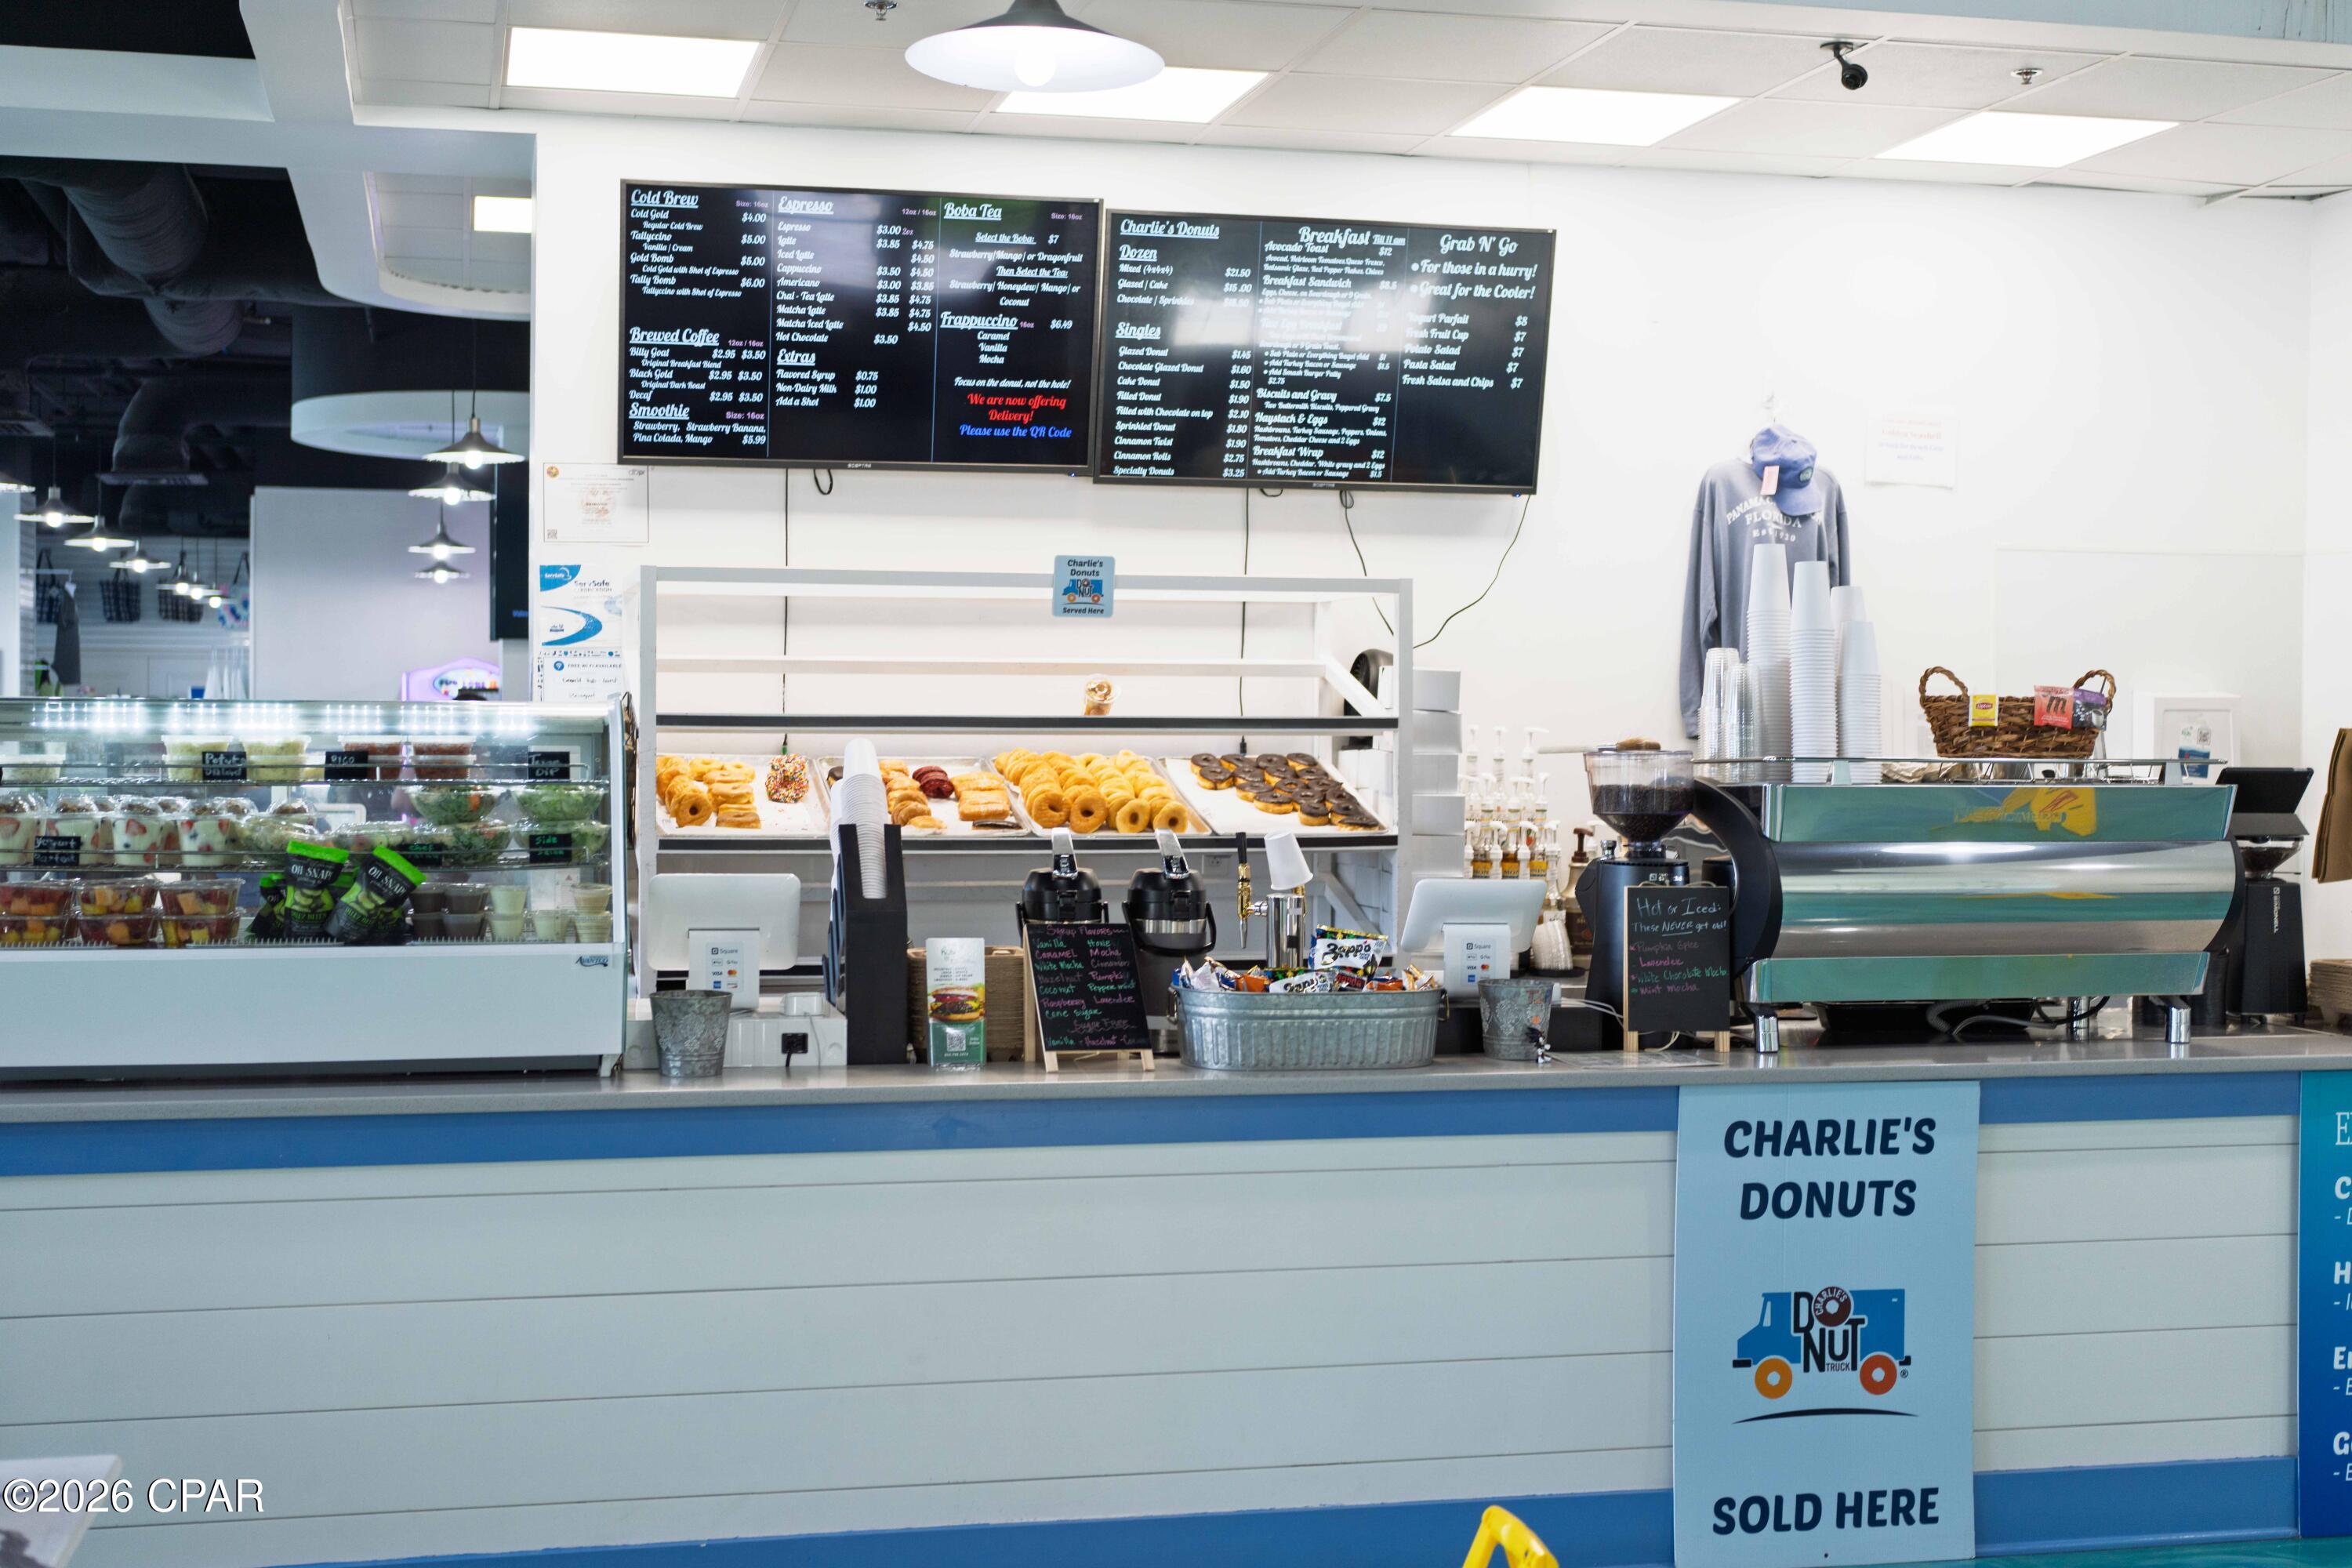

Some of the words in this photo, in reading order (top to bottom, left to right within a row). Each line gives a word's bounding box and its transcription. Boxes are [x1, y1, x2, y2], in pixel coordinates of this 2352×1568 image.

[631, 189, 660, 205] Cold
[663, 190, 699, 205] Brew
[778, 195, 834, 215] Espresso
[944, 202, 976, 217] Boba
[979, 204, 1002, 219] Tea
[630, 209, 648, 218] Cold
[650, 209, 669, 220] Gold
[742, 213, 766, 223] $4.00
[1120, 219, 1174, 234] Charlie's
[1177, 221, 1219, 237] Donuts
[1298, 226, 1371, 249] Breakfast
[1439, 234, 1475, 254] Grab
[1498, 237, 1518, 256] Go
[778, 249, 794, 259] Iced
[796, 250, 815, 261] Latte
[1120, 244, 1157, 259] Dozen
[1265, 241, 1303, 252] Avocado
[1305, 243, 1329, 253] Toast
[1379, 247, 1392, 256] $12
[630, 252, 648, 263] Gold
[651, 253, 673, 263] Bomb
[777, 263, 822, 275] Cappuccino
[1421, 260, 1440, 274] For
[1443, 262, 1472, 274] those
[1475, 263, 1486, 275] in
[1488, 267, 1496, 275] a
[1498, 263, 1537, 281] hurry!
[630, 274, 651, 286] Tally
[652, 276, 676, 285] Bomb
[740, 278, 765, 289] $6.00
[777, 277, 820, 287] Americano
[877, 280, 901, 290] $3.00
[1263, 274, 1306, 289] Breakfast
[1308, 276, 1352, 288] Sandwich
[1420, 281, 1450, 298] Great
[1451, 283, 1471, 299] for
[1473, 284, 1491, 298] the
[1494, 285, 1536, 299] Cooler!
[940, 311, 1018, 329] Frappuccino
[1050, 320, 1073, 330] $6.49
[630, 326, 679, 342] Brewed
[682, 328, 720, 347] Coffee
[978, 332, 1009, 340] Caramel
[1116, 322, 1160, 339] Singles
[775, 332, 789, 341] Hot
[792, 332, 829, 343] Chocolate
[874, 334, 898, 345] $3.50
[630, 347, 649, 358] Billy
[651, 347, 670, 358] Goat
[978, 343, 1007, 352] Vanilla
[777, 349, 815, 364] Extras
[979, 354, 1004, 364] Mocha
[1118, 361, 1153, 371] Chocolate
[1155, 362, 1179, 372] Glazed
[1181, 364, 1203, 372] Donut
[1231, 365, 1251, 375] $1.60
[1403, 359, 1428, 369] Pasta
[1429, 360, 1456, 370] Salad
[630, 369, 653, 378] Black
[655, 369, 673, 379] Gold
[709, 370, 732, 380] $2.95
[738, 371, 762, 381] $3.50
[776, 368, 809, 379] Flavored
[811, 370, 836, 382] Syrup
[855, 370, 878, 381] $0.75
[1403, 375, 1425, 385] Fresh
[1427, 376, 1450, 386] Salsa
[1452, 377, 1469, 387] and
[1470, 376, 1494, 390] Chips
[630, 390, 653, 401] Decaf
[967, 393, 985, 405] We
[986, 396, 1003, 405] are
[1005, 397, 1026, 405] now
[1029, 395, 1066, 409] offering
[1257, 388, 1290, 399] Biscuits
[1291, 390, 1309, 399] and
[1311, 389, 1337, 402] Gravy
[1375, 393, 1391, 403] $7.5
[629, 402, 690, 417] Smoothie
[989, 409, 1034, 424] Delivery!
[1255, 412, 1296, 425] Haystack
[1298, 414, 1305, 423] &
[1307, 414, 1328, 426] Eggs
[633, 421, 680, 432] Strawberry,
[686, 422, 730, 434] Strawberry
[960, 424, 991, 436] Please
[994, 427, 1009, 436] use
[1012, 426, 1028, 437] the
[1029, 426, 1045, 437] QR
[1048, 426, 1072, 437] Code
[633, 433, 652, 442] Pina
[654, 434, 683, 444] Colada,
[685, 434, 713, 445] Mango
[742, 435, 766, 445] $5.99
[1114, 451, 1151, 460] Cinnamon
[1153, 452, 1171, 461] Rolls
[1113, 466, 1148, 477] Specialty
[1223, 469, 1245, 477] $3.25
[1745, 510, 1802, 528] FLORIDA
[1068, 559, 1103, 568] Charlie's
[291, 864, 303, 874] OH
[368, 866, 382, 880] OH
[1637, 897, 1662, 916] Hot
[1668, 905, 1678, 914] or
[1632, 922, 1660, 932] These
[1662, 921, 1693, 932] NEVER
[1695, 921, 1708, 933] get
[1723, 1117, 1936, 1158] CHARLIE'S
[1740, 1180, 1916, 1220] DONUTS
[1816, 1288, 1847, 1316] CHARLIE'S
[1826, 1363, 1849, 1371] TRUCK
[1712, 1494, 1822, 1535] SOLD
[1835, 1488, 1940, 1528] HERE
